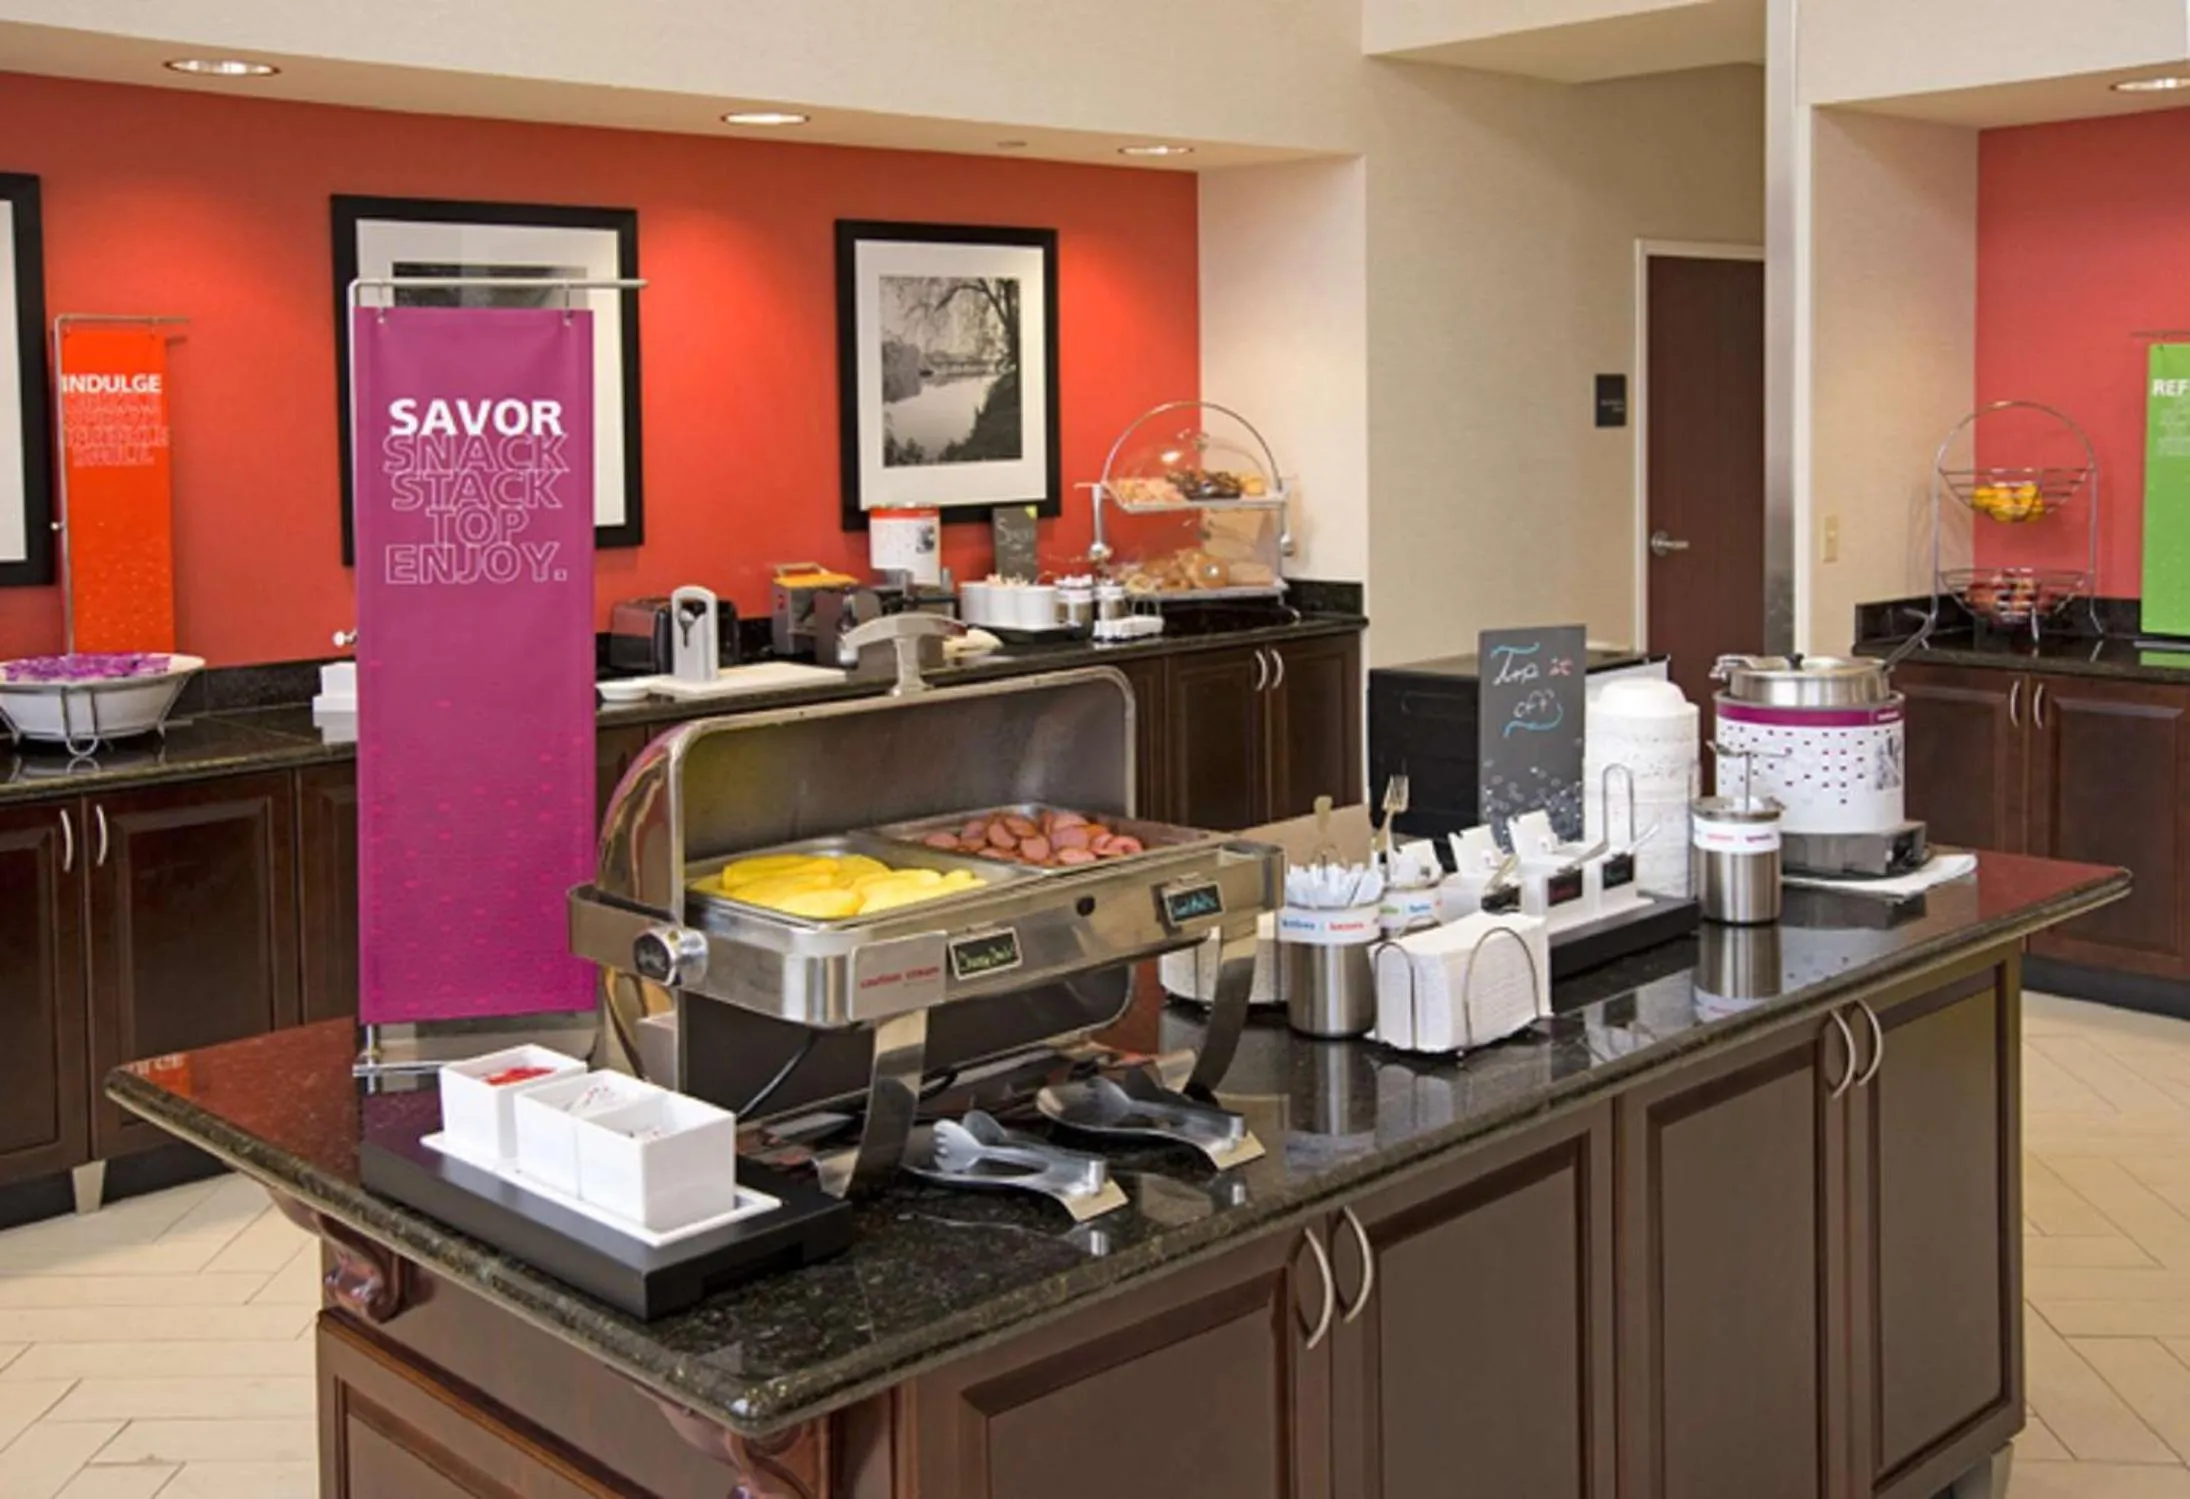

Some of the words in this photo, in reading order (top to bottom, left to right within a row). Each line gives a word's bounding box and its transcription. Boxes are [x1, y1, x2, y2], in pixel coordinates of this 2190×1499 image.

[61, 373, 162, 393] INDULGE
[2151, 379, 2190, 397] REF
[388, 398, 563, 436] SAVOR
[382, 432, 571, 474] SNACK
[391, 467, 564, 511] STACK
[425, 503, 530, 547] TOP
[385, 541, 568, 584] ENJOY.
